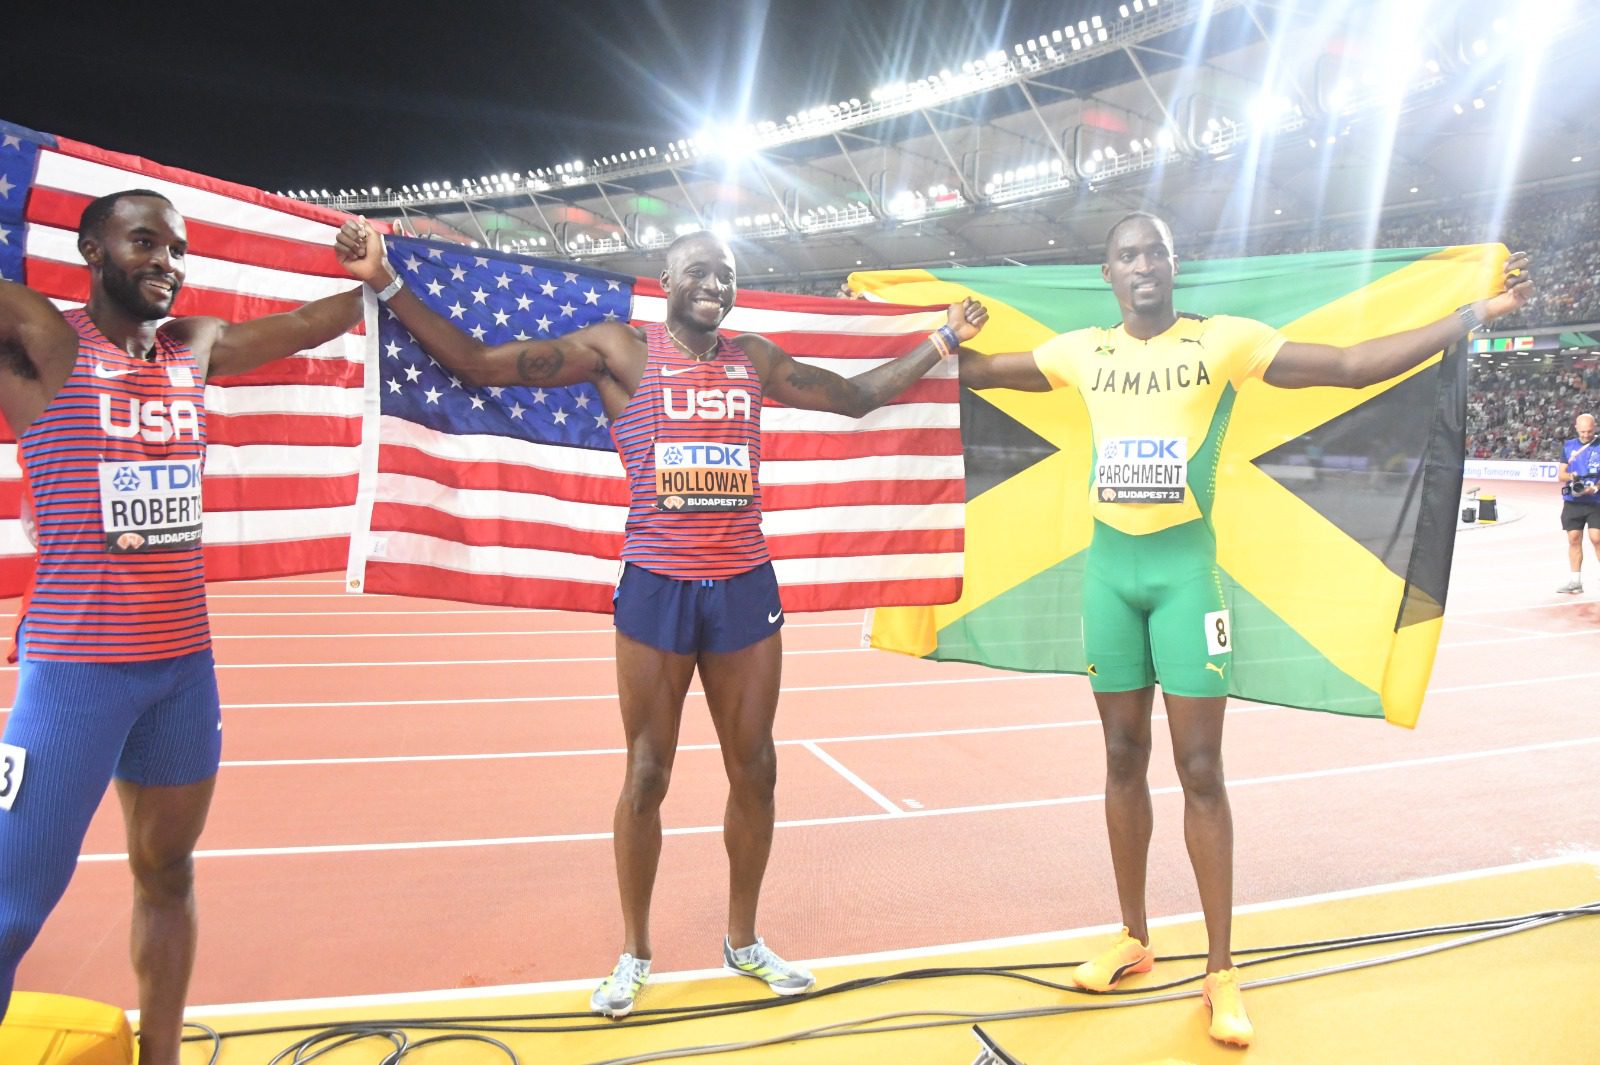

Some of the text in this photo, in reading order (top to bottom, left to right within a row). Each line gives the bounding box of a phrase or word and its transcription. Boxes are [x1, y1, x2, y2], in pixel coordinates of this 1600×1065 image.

[1091, 360, 1210, 396] JAMAICA
[663, 387, 751, 420] USA
[99, 393, 200, 442] USA
[683, 445, 743, 467] TDK
[1119, 439, 1179, 459] TDK
[138, 463, 200, 491] TDK
[661, 471, 748, 493] HOLLOWAY
[1099, 463, 1183, 485] PARCHMENT
[1539, 465, 1558, 479] TD
[687, 497, 748, 507] BUDAPEST 23
[1117, 490, 1180, 499] BUDAPEST 23
[1215, 617, 1227, 648] 8
[0, 755, 15, 798] 3
